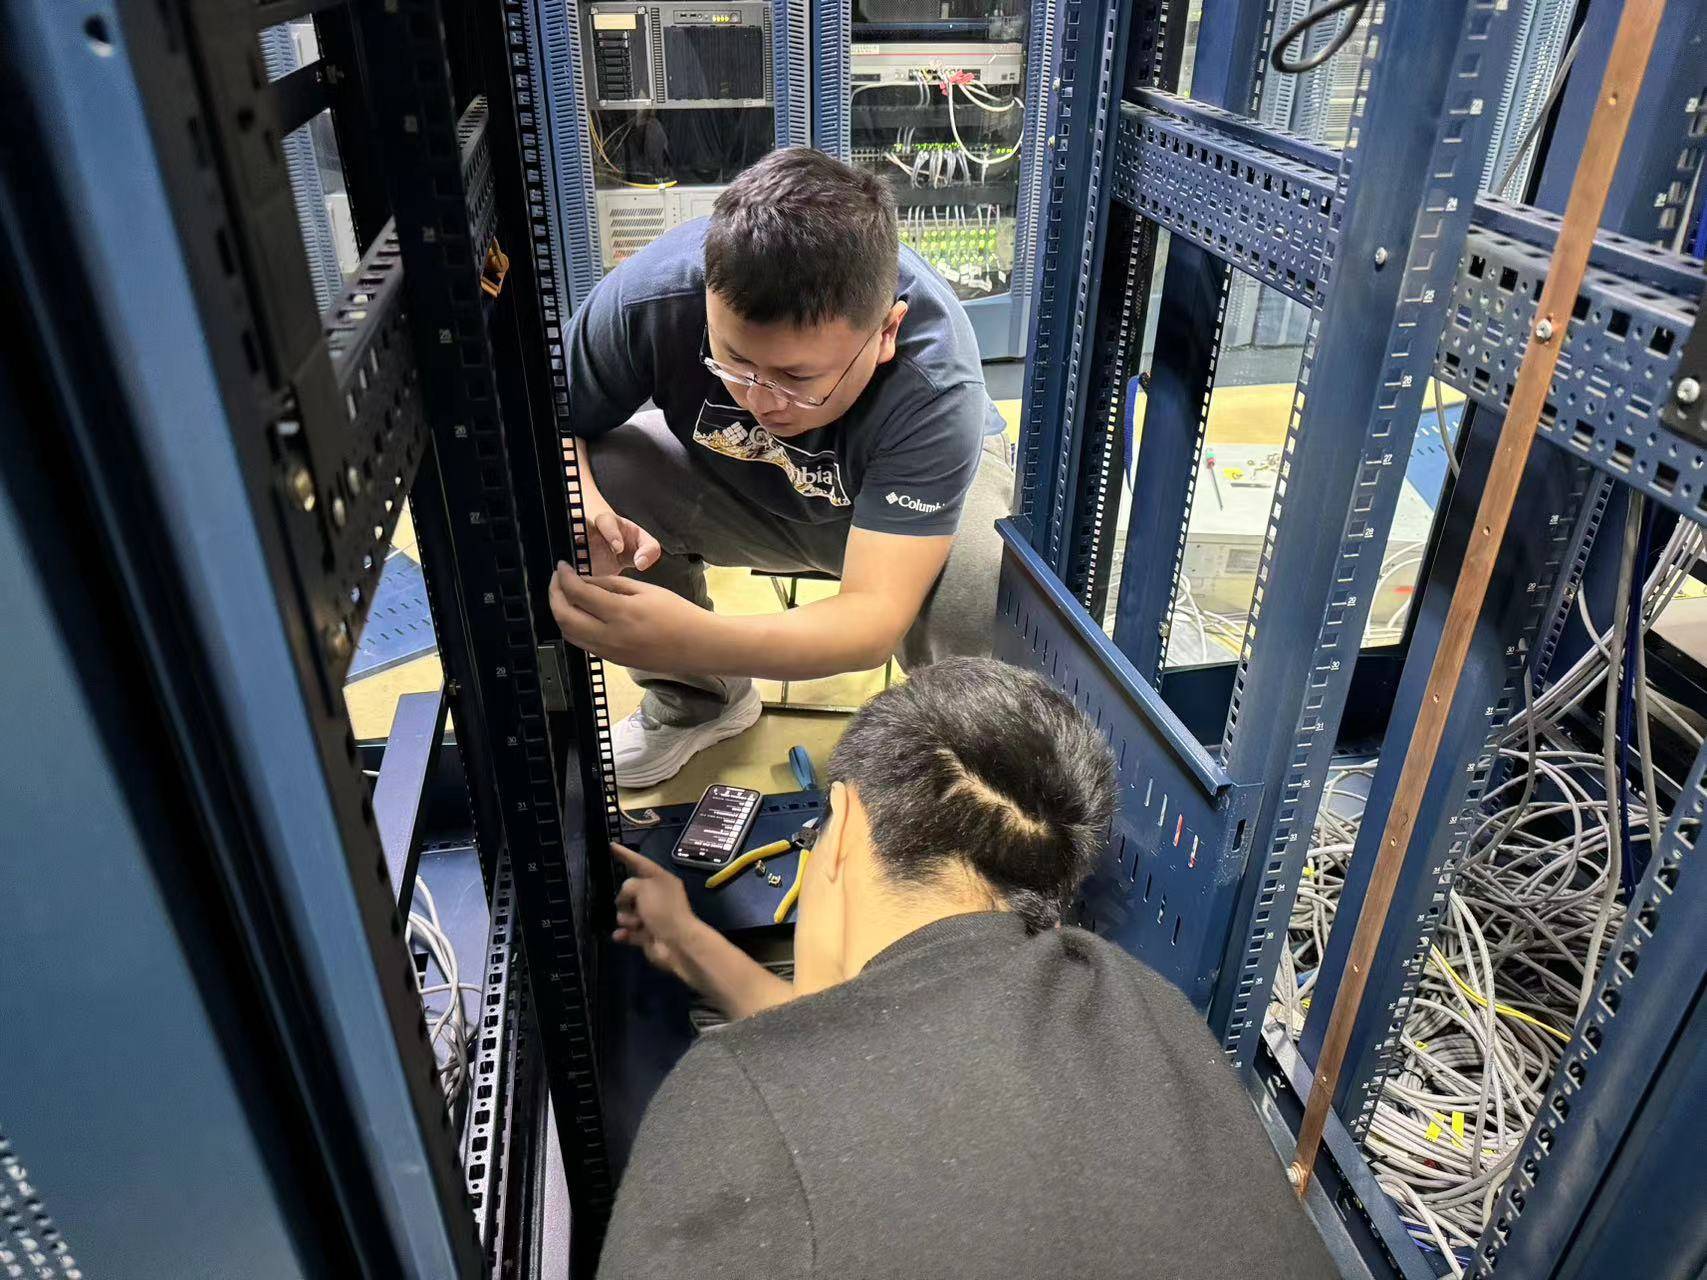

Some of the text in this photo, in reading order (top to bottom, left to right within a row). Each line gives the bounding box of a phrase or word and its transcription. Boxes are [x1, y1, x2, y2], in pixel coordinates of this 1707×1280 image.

[1423, 290, 1436, 303] 25
[1383, 454, 1393, 465] 27
[470, 512, 481, 524] 27
[1527, 582, 1537, 592] 29
[1347, 597, 1357, 606] 29
[1506, 646, 1515, 655] 30
[1330, 661, 1341, 670] 30
[496, 667, 507, 677] 29
[1485, 707, 1494, 716] 31
[1315, 722, 1324, 731] 31
[507, 736, 518, 746] 30
[1466, 763, 1475, 772] 32
[1302, 779, 1311, 788] 32
[517, 802, 528, 810] 31
